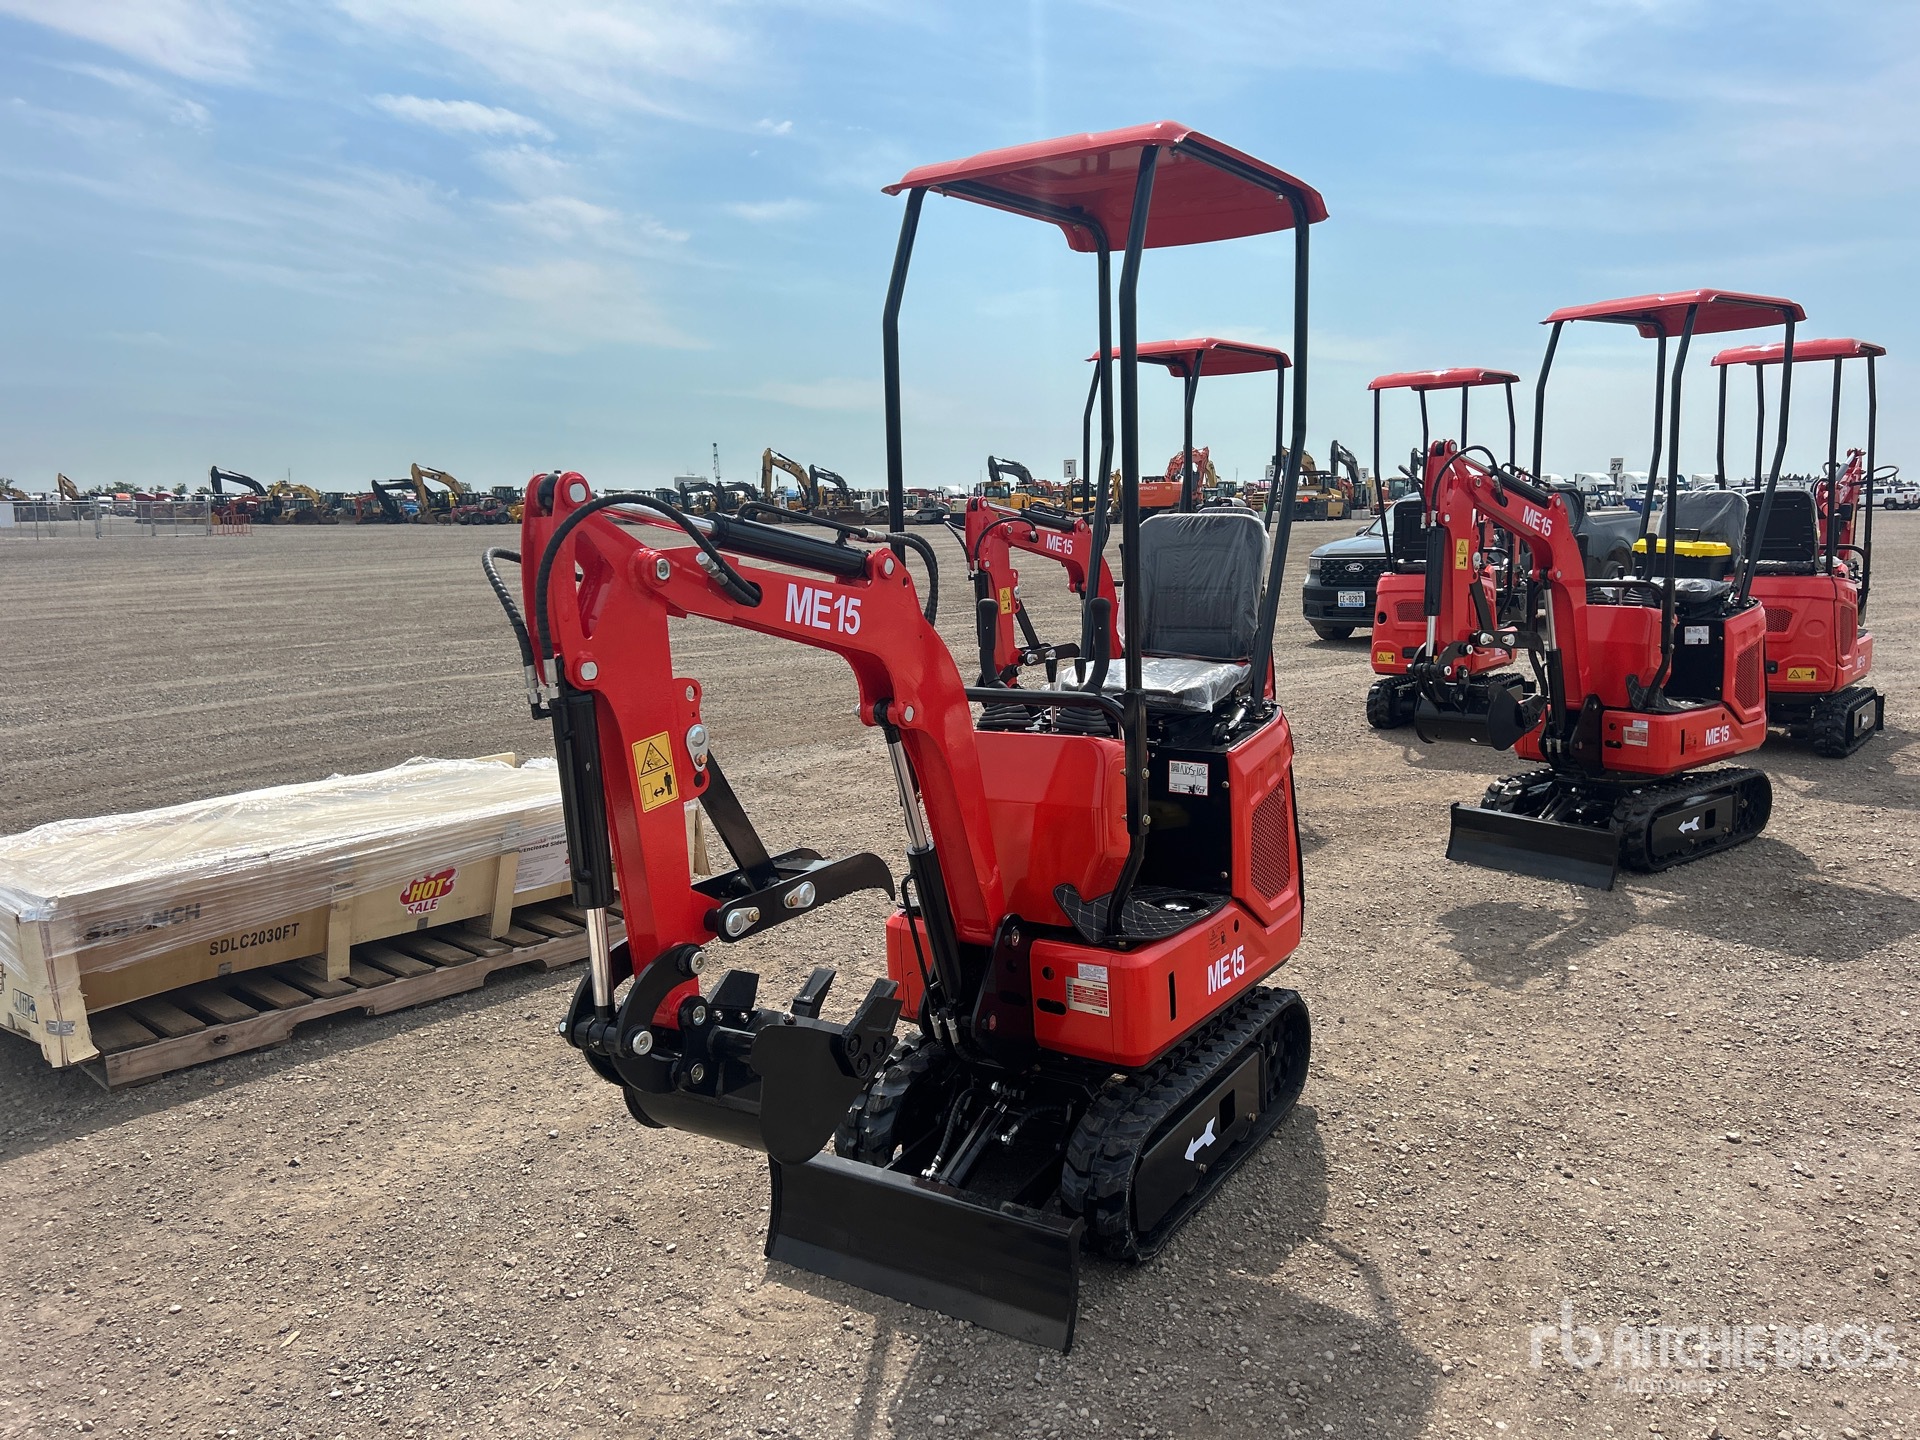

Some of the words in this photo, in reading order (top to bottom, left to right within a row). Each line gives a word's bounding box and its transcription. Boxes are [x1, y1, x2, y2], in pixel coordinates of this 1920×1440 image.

[1067, 465, 1072, 474] 1
[1611, 463, 1622, 471] 27
[1522, 505, 1553, 537] ME15
[1046, 533, 1073, 555] ME15
[785, 583, 861, 635] ME15
[1705, 725, 1731, 746] ME15
[408, 877, 447, 903] HOT
[407, 899, 438, 914] SALE
[209, 922, 300, 956] SDLC2030FT
[1207, 945, 1245, 996] ME15
